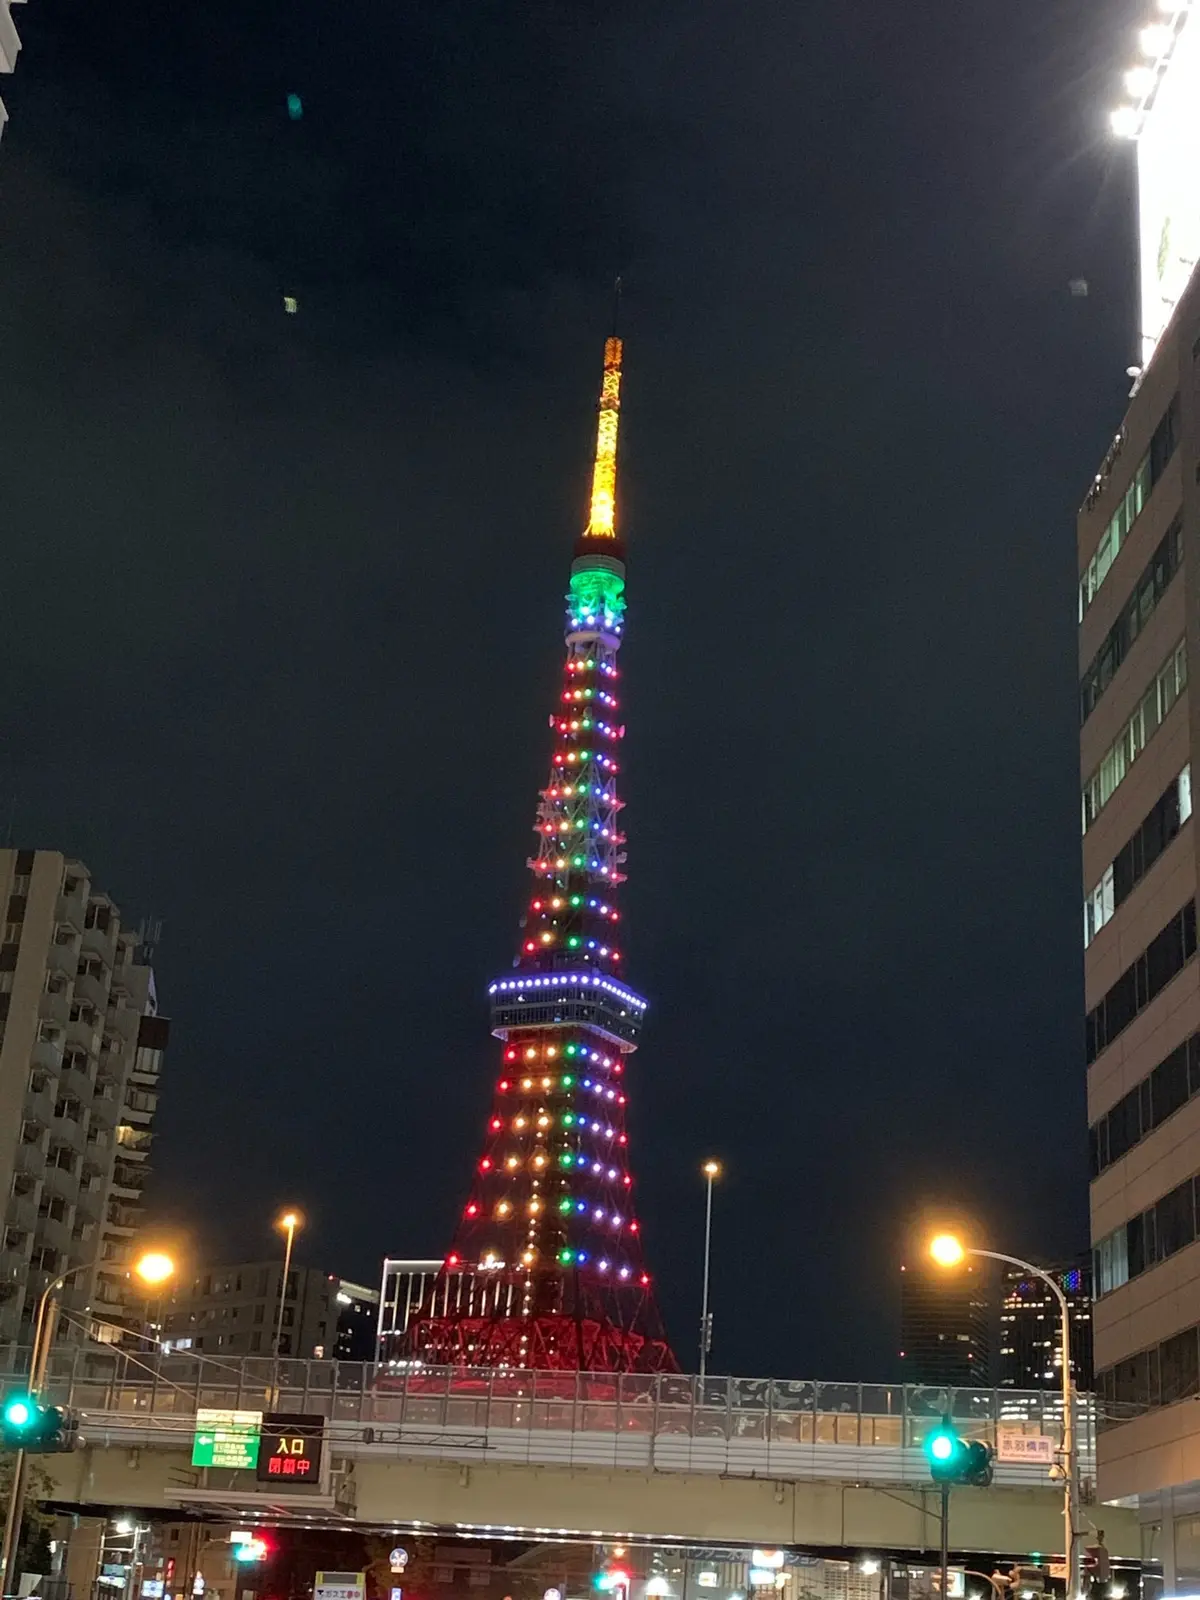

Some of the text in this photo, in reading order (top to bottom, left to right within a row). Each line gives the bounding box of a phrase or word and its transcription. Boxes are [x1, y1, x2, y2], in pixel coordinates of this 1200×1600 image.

[276, 1438, 304, 1454] 入口
[268, 1457, 310, 1475] 閉鎖中
